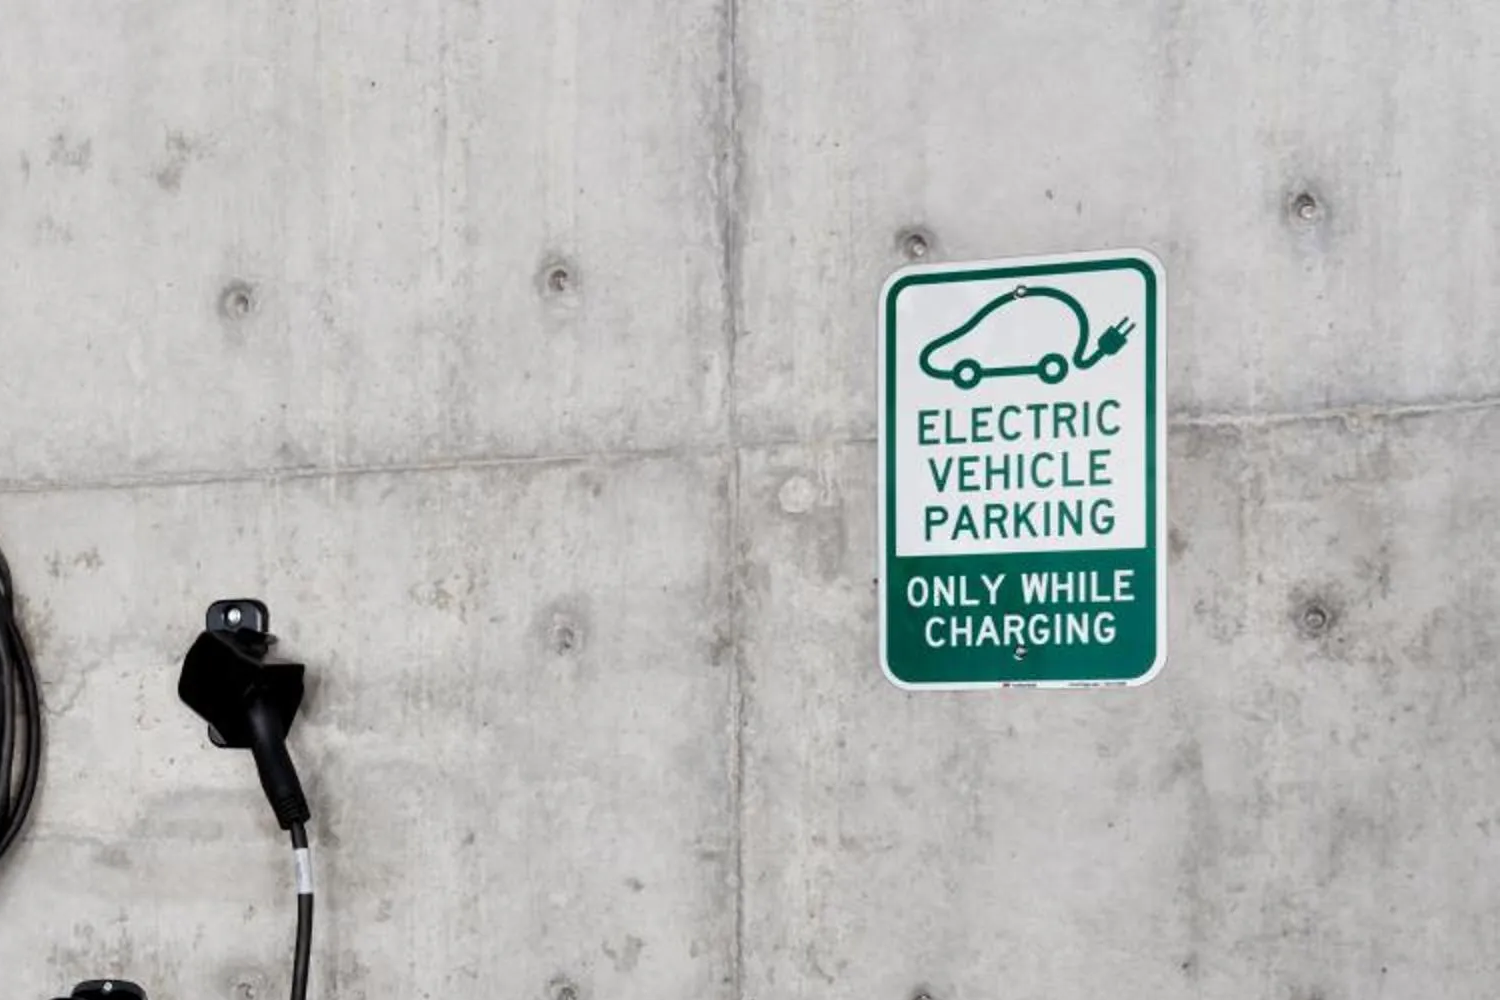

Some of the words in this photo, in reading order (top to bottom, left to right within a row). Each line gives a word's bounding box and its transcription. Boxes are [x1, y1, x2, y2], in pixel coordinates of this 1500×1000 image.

[918, 399, 1121, 446] ELECTRIC
[928, 449, 1112, 493] VEHICLE
[924, 498, 1116, 542] PARKING
[906, 574, 1006, 608] ONLY
[1020, 569, 1135, 604] WHILE
[924, 611, 1117, 648] CHARGING
